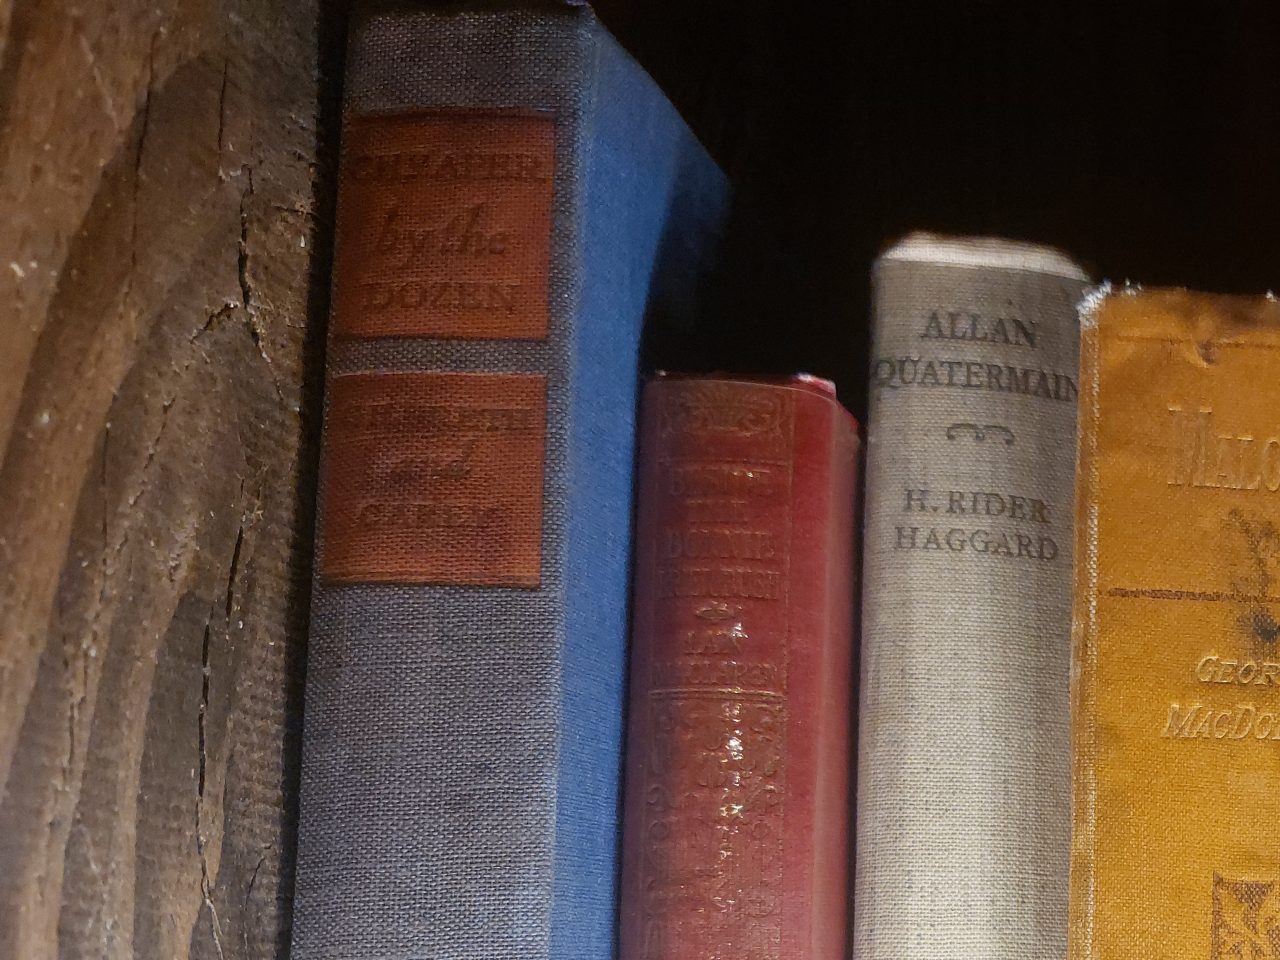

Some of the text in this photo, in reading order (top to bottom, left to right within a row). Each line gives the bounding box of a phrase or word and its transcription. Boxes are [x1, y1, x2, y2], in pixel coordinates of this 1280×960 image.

[920, 311, 1044, 348] ALLAN
[872, 356, 1079, 401] QUATERMAIN
[903, 489, 1051, 524] H. RIDER
[894, 527, 1060, 561] HAGGARD
